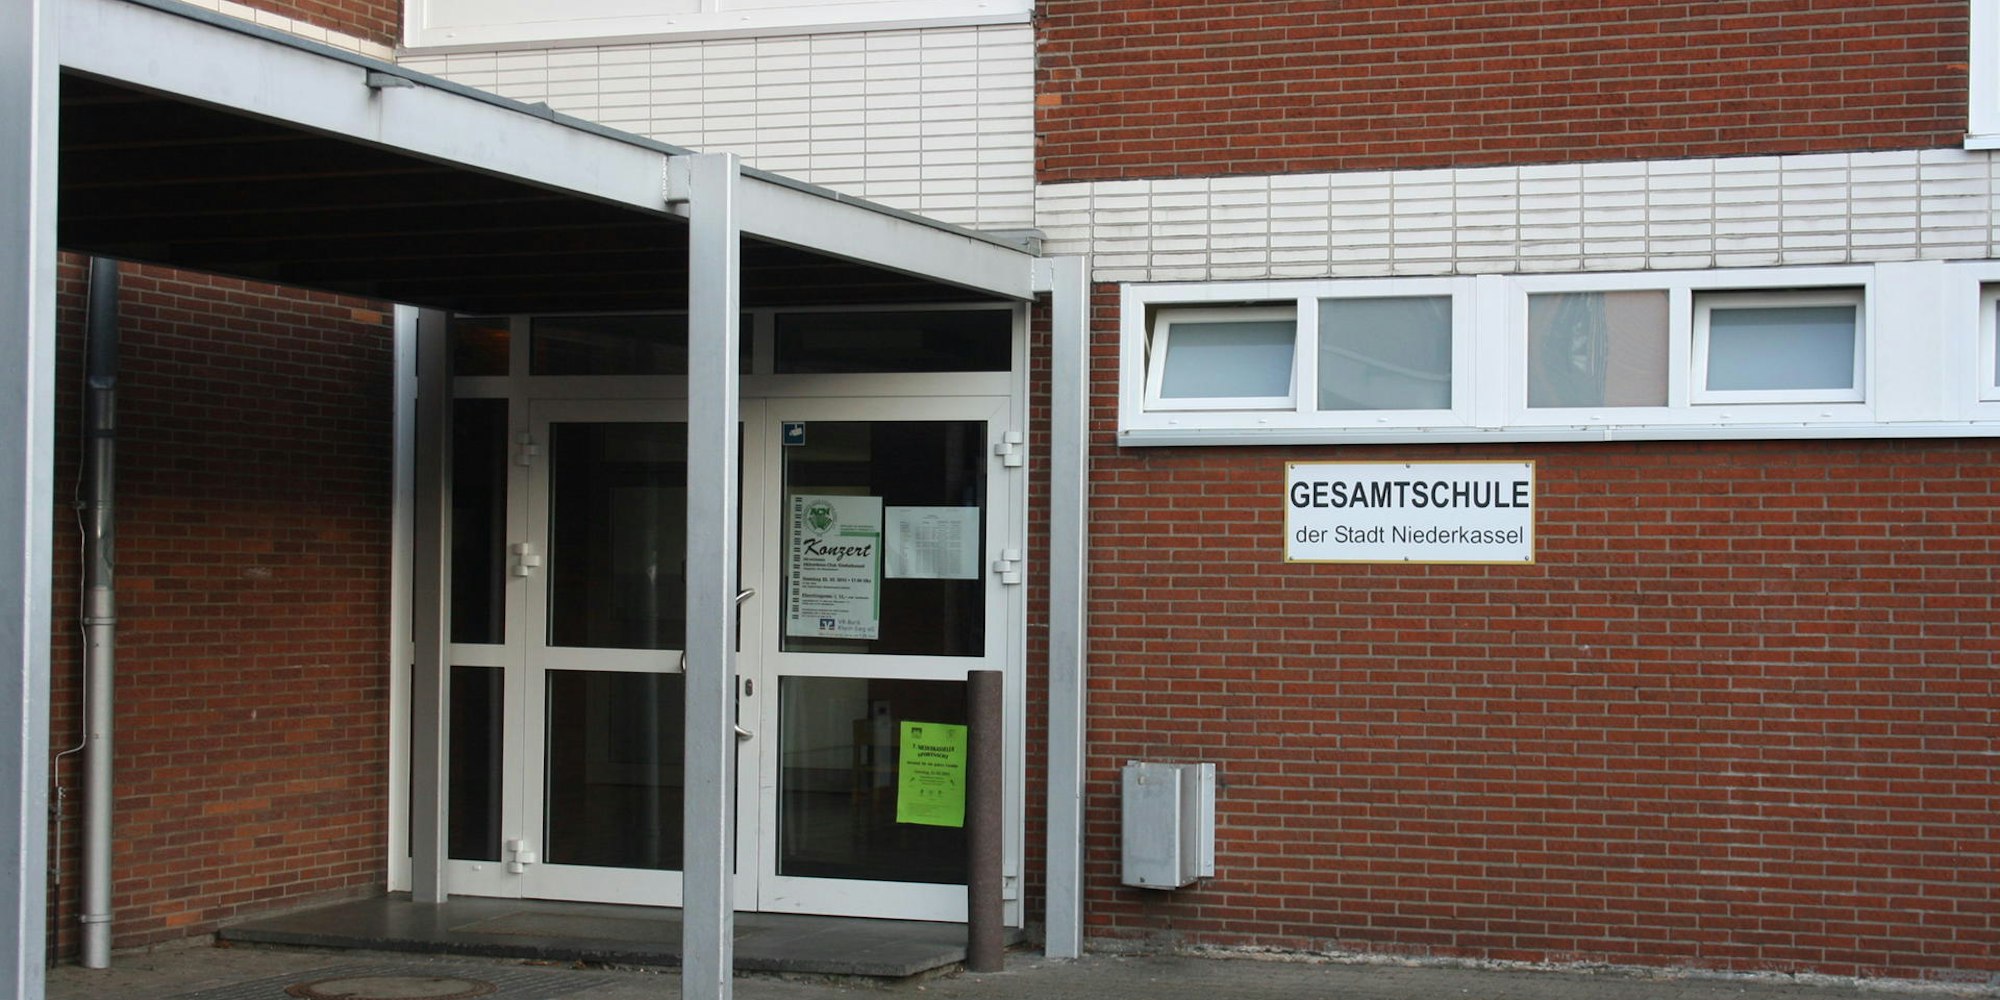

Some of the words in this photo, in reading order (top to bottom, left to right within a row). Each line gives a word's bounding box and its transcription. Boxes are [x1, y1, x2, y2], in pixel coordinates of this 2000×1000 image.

[1290, 480, 1530, 509] GESAMTSCHULE
[1295, 525, 1328, 544] der
[1334, 525, 1385, 544] Stadt
[1392, 525, 1523, 544] Niederkassel
[803, 538, 872, 562] Konzert
